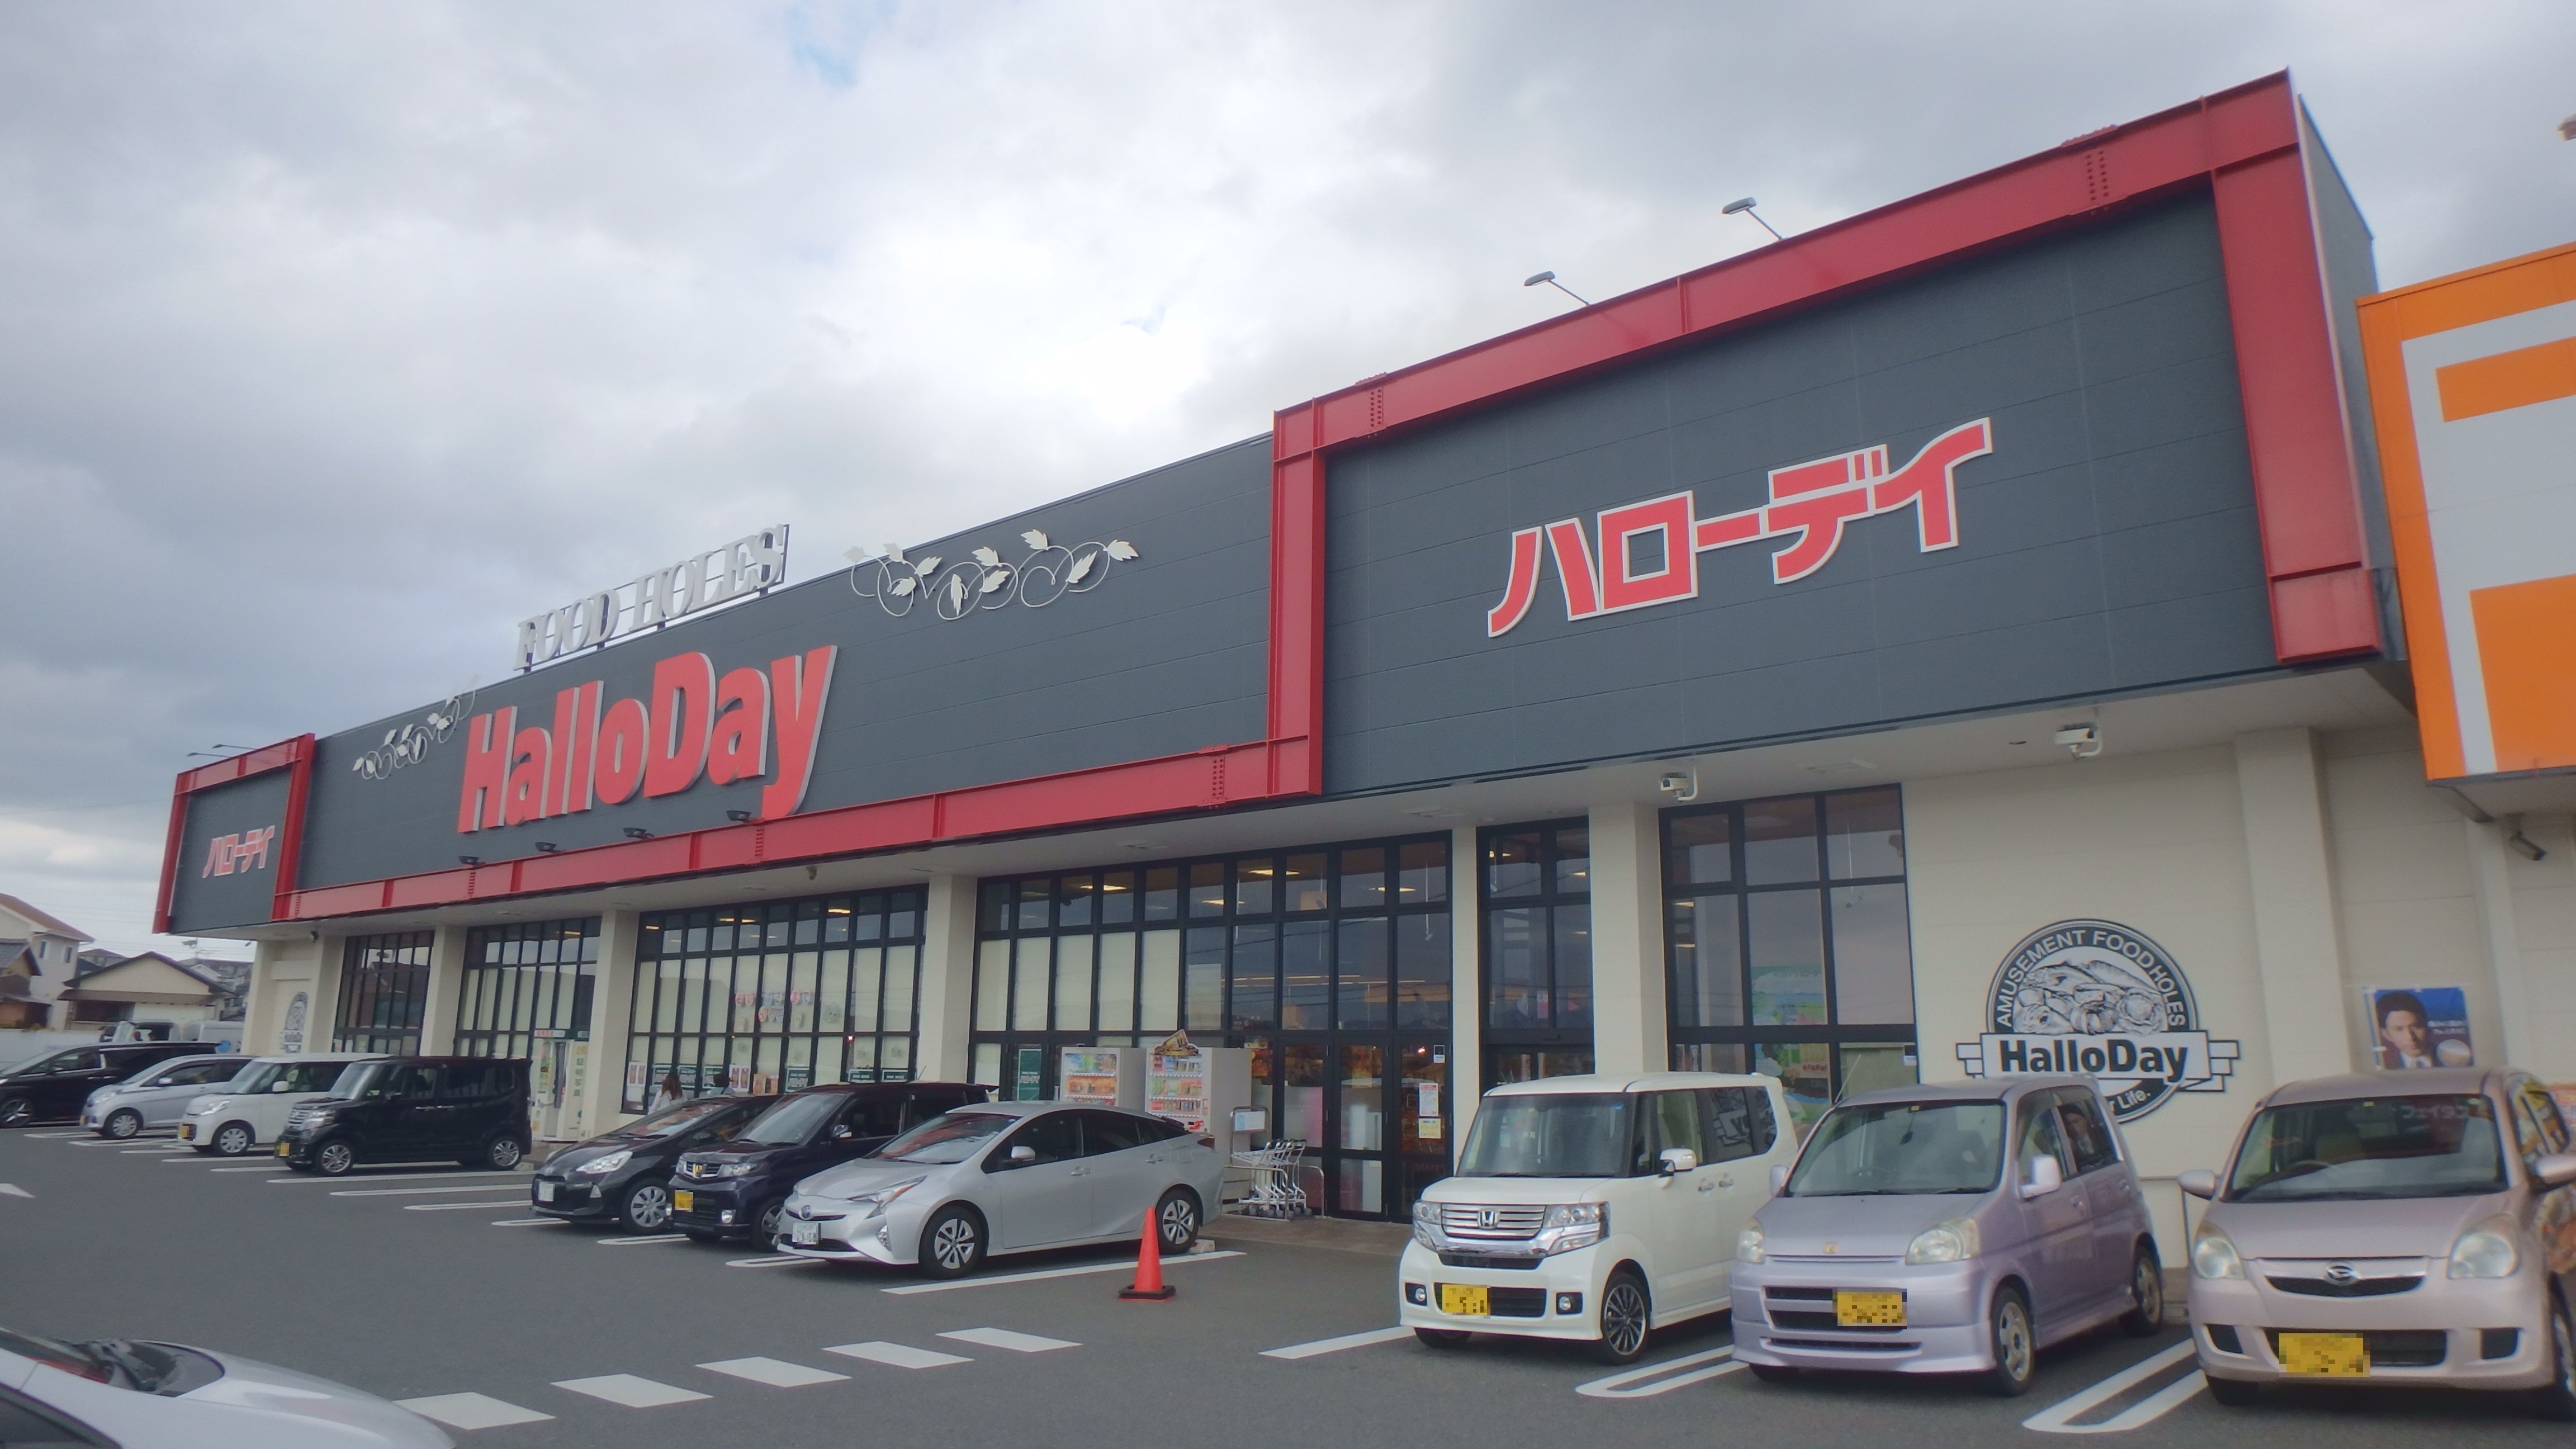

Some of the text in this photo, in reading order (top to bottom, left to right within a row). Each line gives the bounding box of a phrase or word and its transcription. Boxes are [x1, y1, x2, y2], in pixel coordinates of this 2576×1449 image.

[513, 524, 784, 670] FOOD HOLES
[458, 645, 838, 833] HalloDay
[1997, 930, 2185, 1027] AMUSEMENT FOOD HOLES
[1999, 1039, 2188, 1082] HalloDay
[2120, 1090, 2151, 1110] Life.
